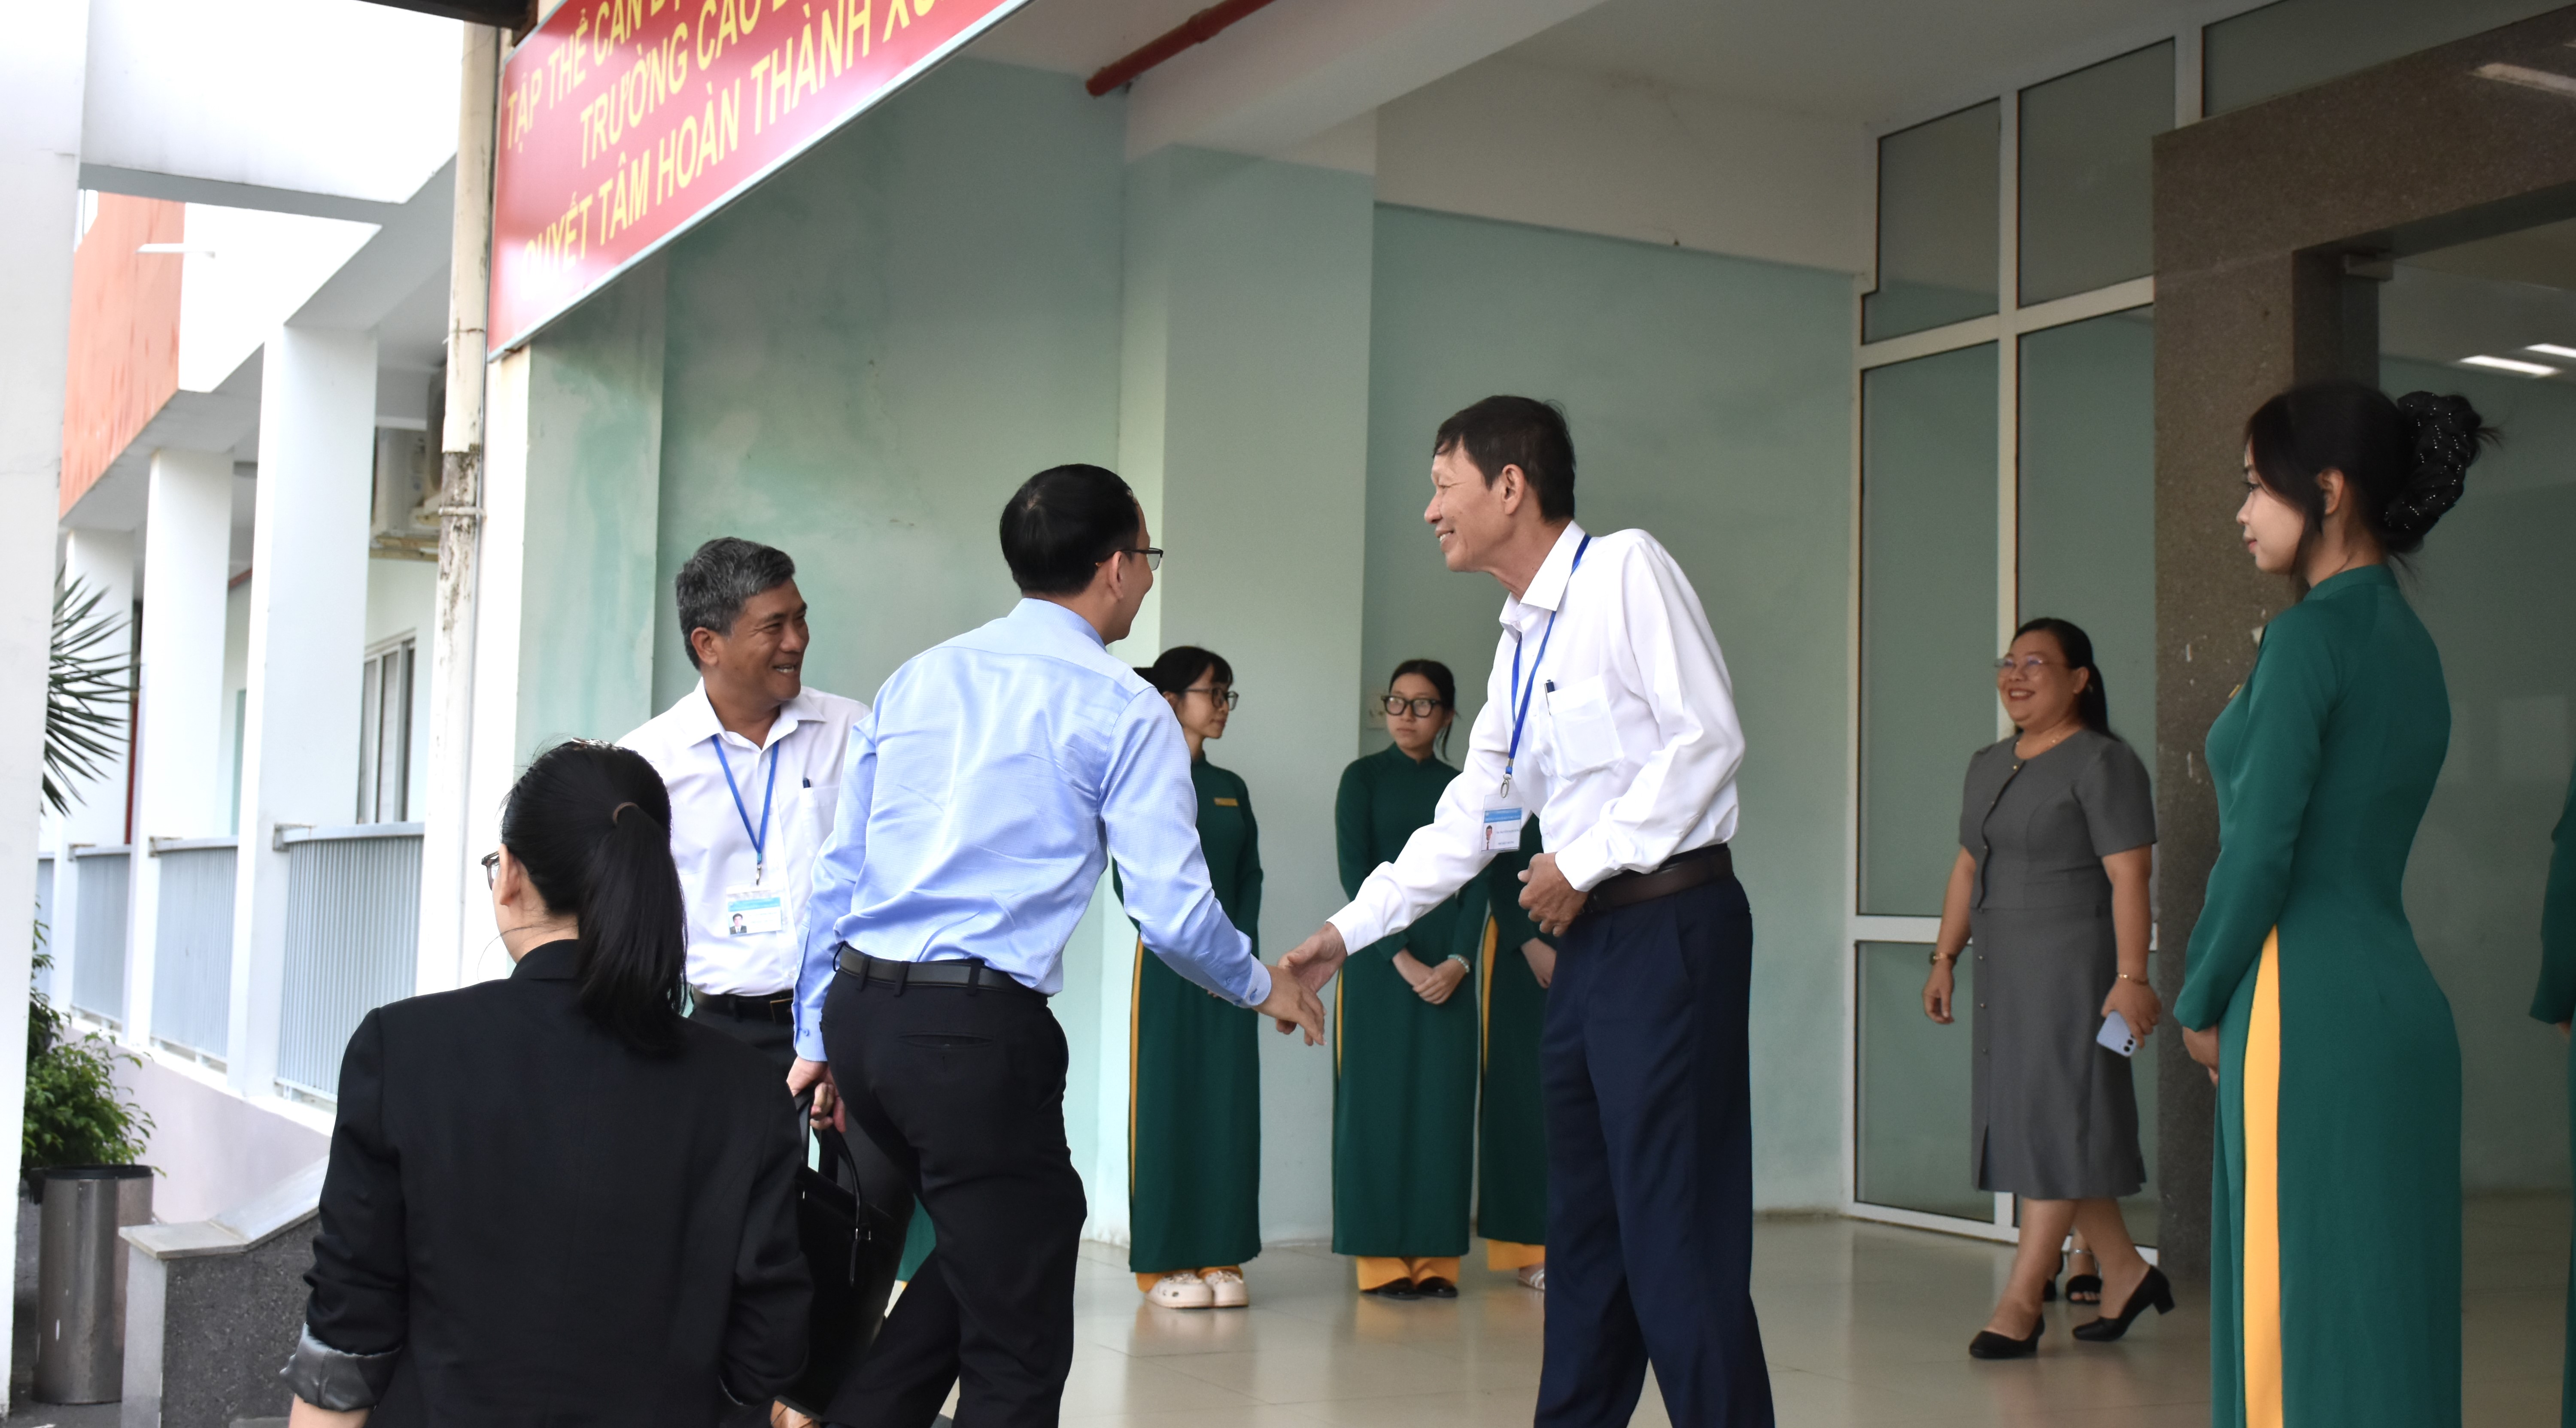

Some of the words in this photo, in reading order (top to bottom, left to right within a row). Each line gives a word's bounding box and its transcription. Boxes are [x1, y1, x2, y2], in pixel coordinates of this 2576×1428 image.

[507, 72, 542, 153] TẬP
[548, 7, 589, 110] THỂ
[580, 22, 688, 169] TRƯỜNG
[598, 149, 650, 246] TÂM
[656, 80, 741, 206] HOÀN
[750, 0, 872, 136] THÀNH
